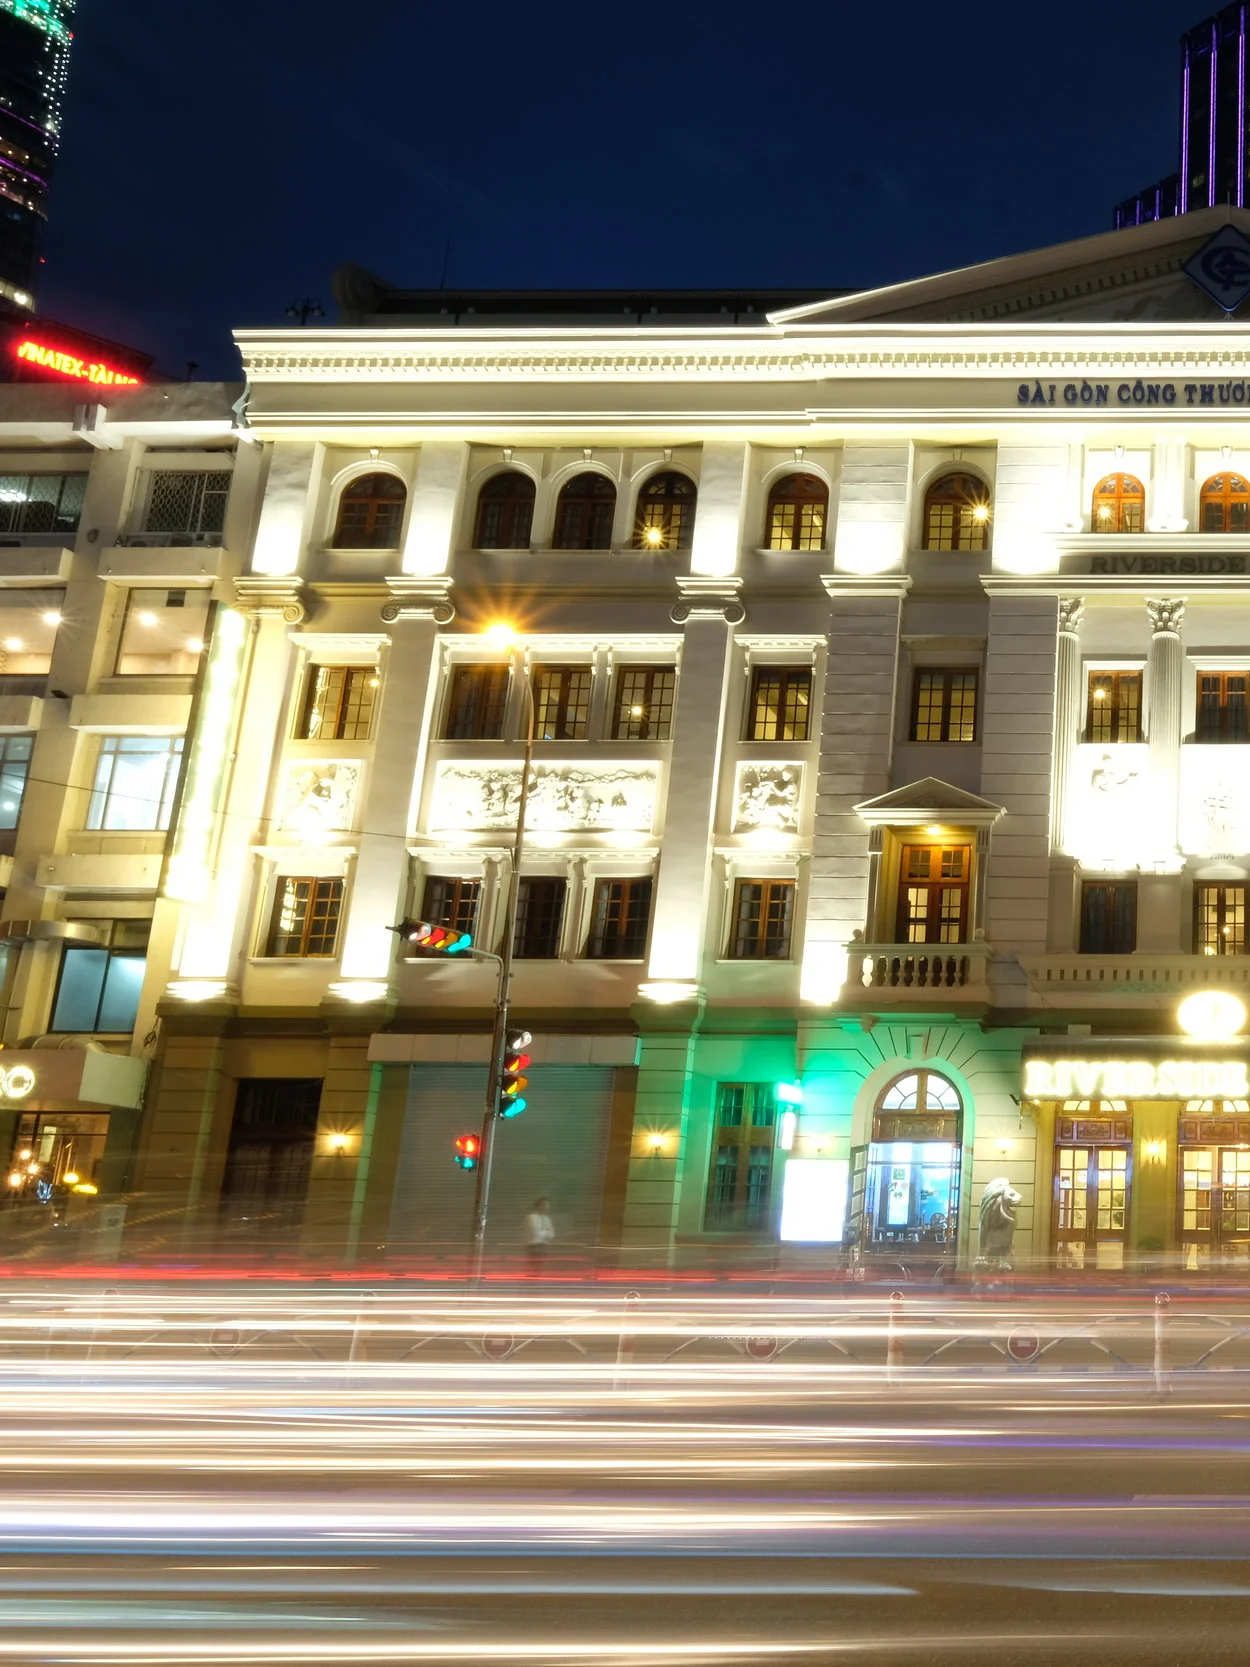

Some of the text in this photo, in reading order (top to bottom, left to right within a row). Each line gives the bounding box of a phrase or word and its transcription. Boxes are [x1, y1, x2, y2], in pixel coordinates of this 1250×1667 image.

[1018, 379, 1056, 404] SÀI
[1063, 379, 1109, 404] GÒN
[1117, 379, 1177, 404] CÔNG
[1089, 556, 1246, 574] RIVERSIDE
[1024, 1061, 1249, 1097] RIVERSIDE
